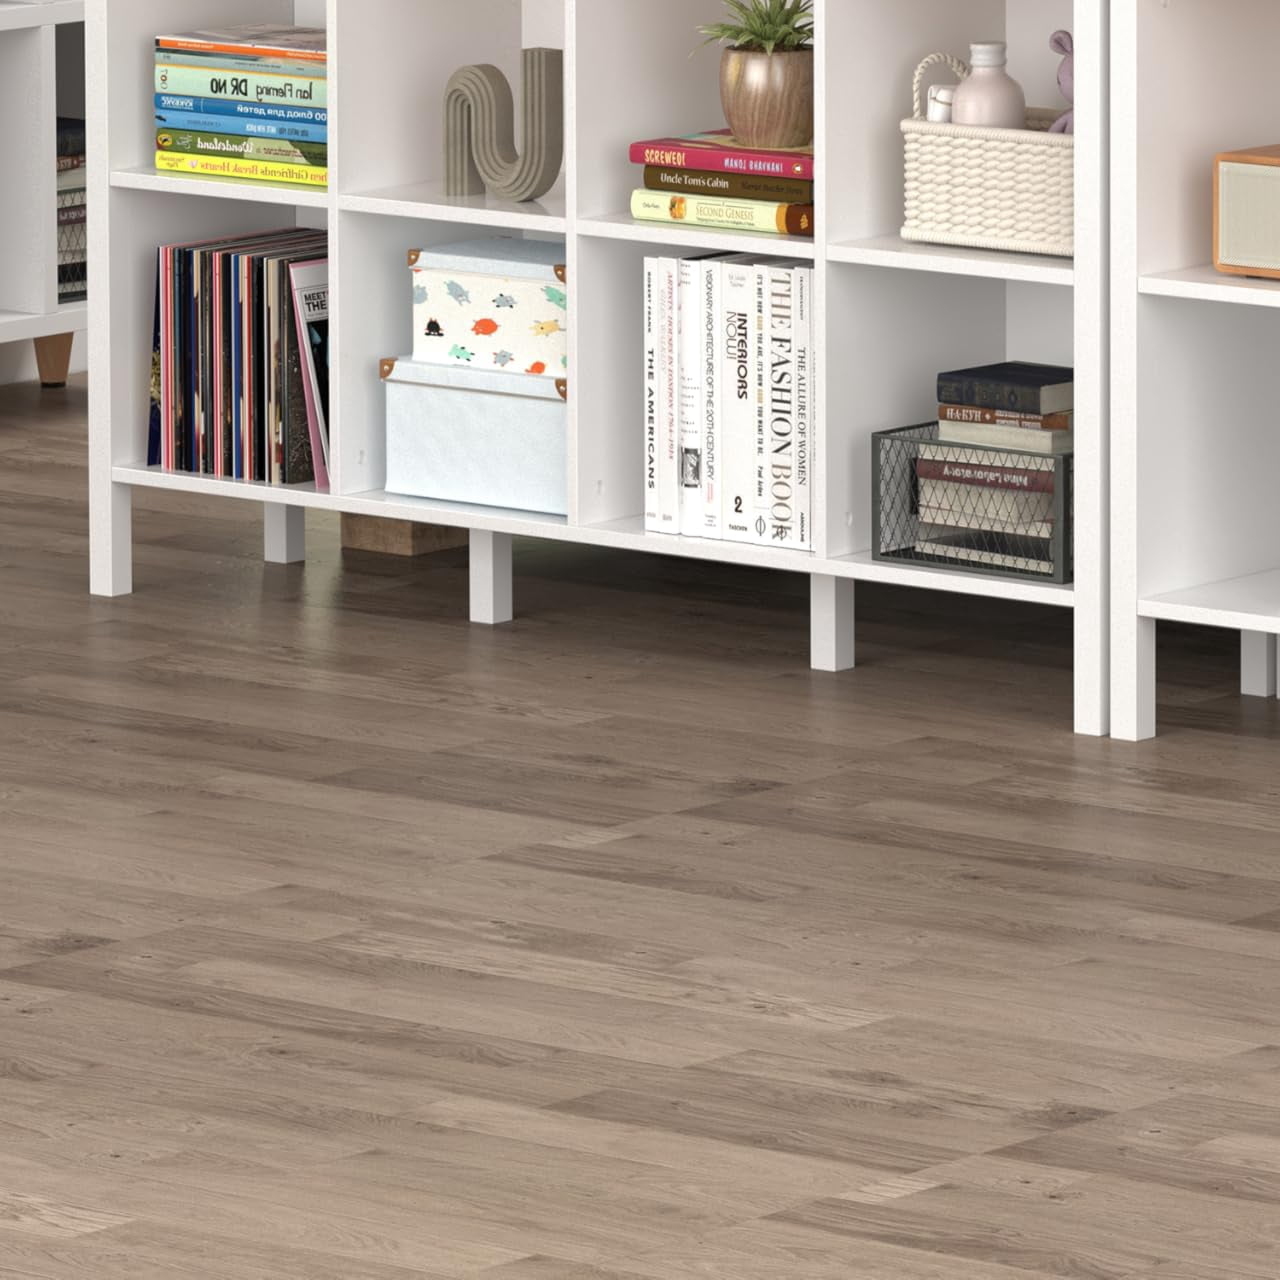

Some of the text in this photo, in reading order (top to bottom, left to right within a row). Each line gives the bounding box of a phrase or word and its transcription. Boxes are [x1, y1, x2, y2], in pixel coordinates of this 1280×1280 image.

[660, 172, 682, 185] Uncle
[682, 175, 706, 187] Tom's
[706, 177, 729, 189] Cabin
[696, 205, 754, 221] SECOND GENESIS
[304, 290, 326, 302] MEET
[305, 299, 327, 313] THE
[705, 311, 714, 376] ARCHITECTURE
[726, 311, 737, 360] NOW!
[737, 312, 748, 400] INTERIORS
[647, 348, 655, 380] THE
[770, 271, 793, 540] THE FASHION BOOK
[797, 347, 807, 486] THE ALLURE OF WOMEN
[647, 386, 655, 489] AMERICANS
[706, 435, 714, 481] CENTURY
[734, 495, 743, 513] 2
